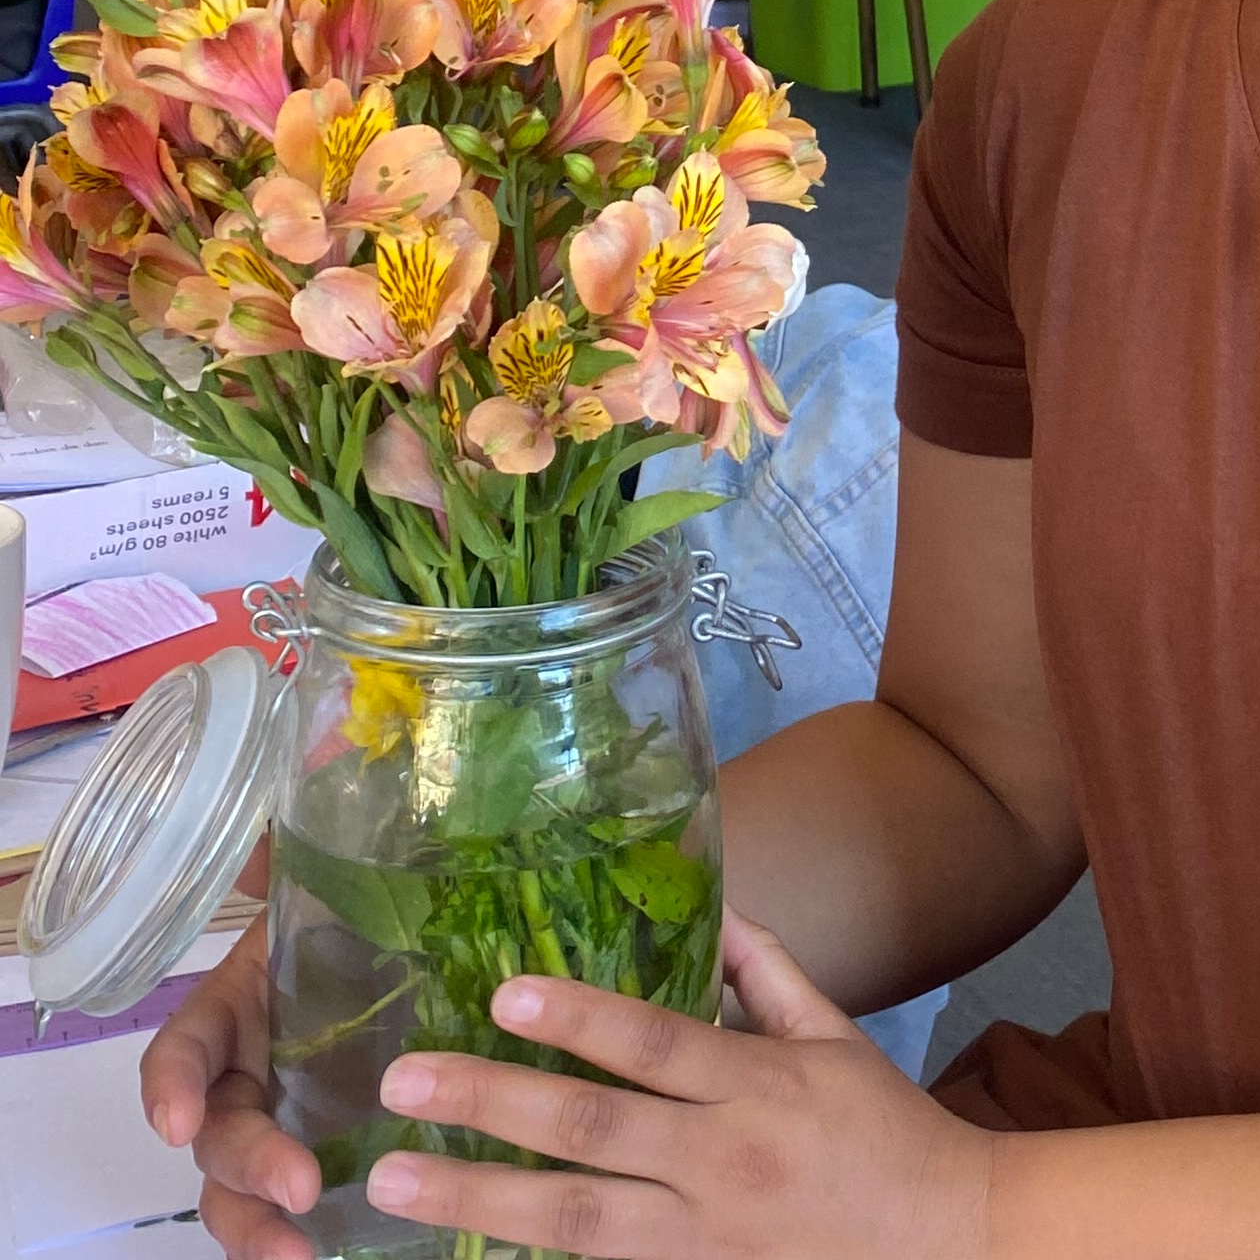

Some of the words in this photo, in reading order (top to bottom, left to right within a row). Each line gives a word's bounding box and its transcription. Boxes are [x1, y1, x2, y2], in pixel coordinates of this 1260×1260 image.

[151, 489, 214, 509] reams
[217, 485, 230, 501] 5
[106, 514, 175, 536] sheets
[179, 505, 229, 526] 2500
[142, 535, 168, 552] 80
[173, 523, 227, 544] white
